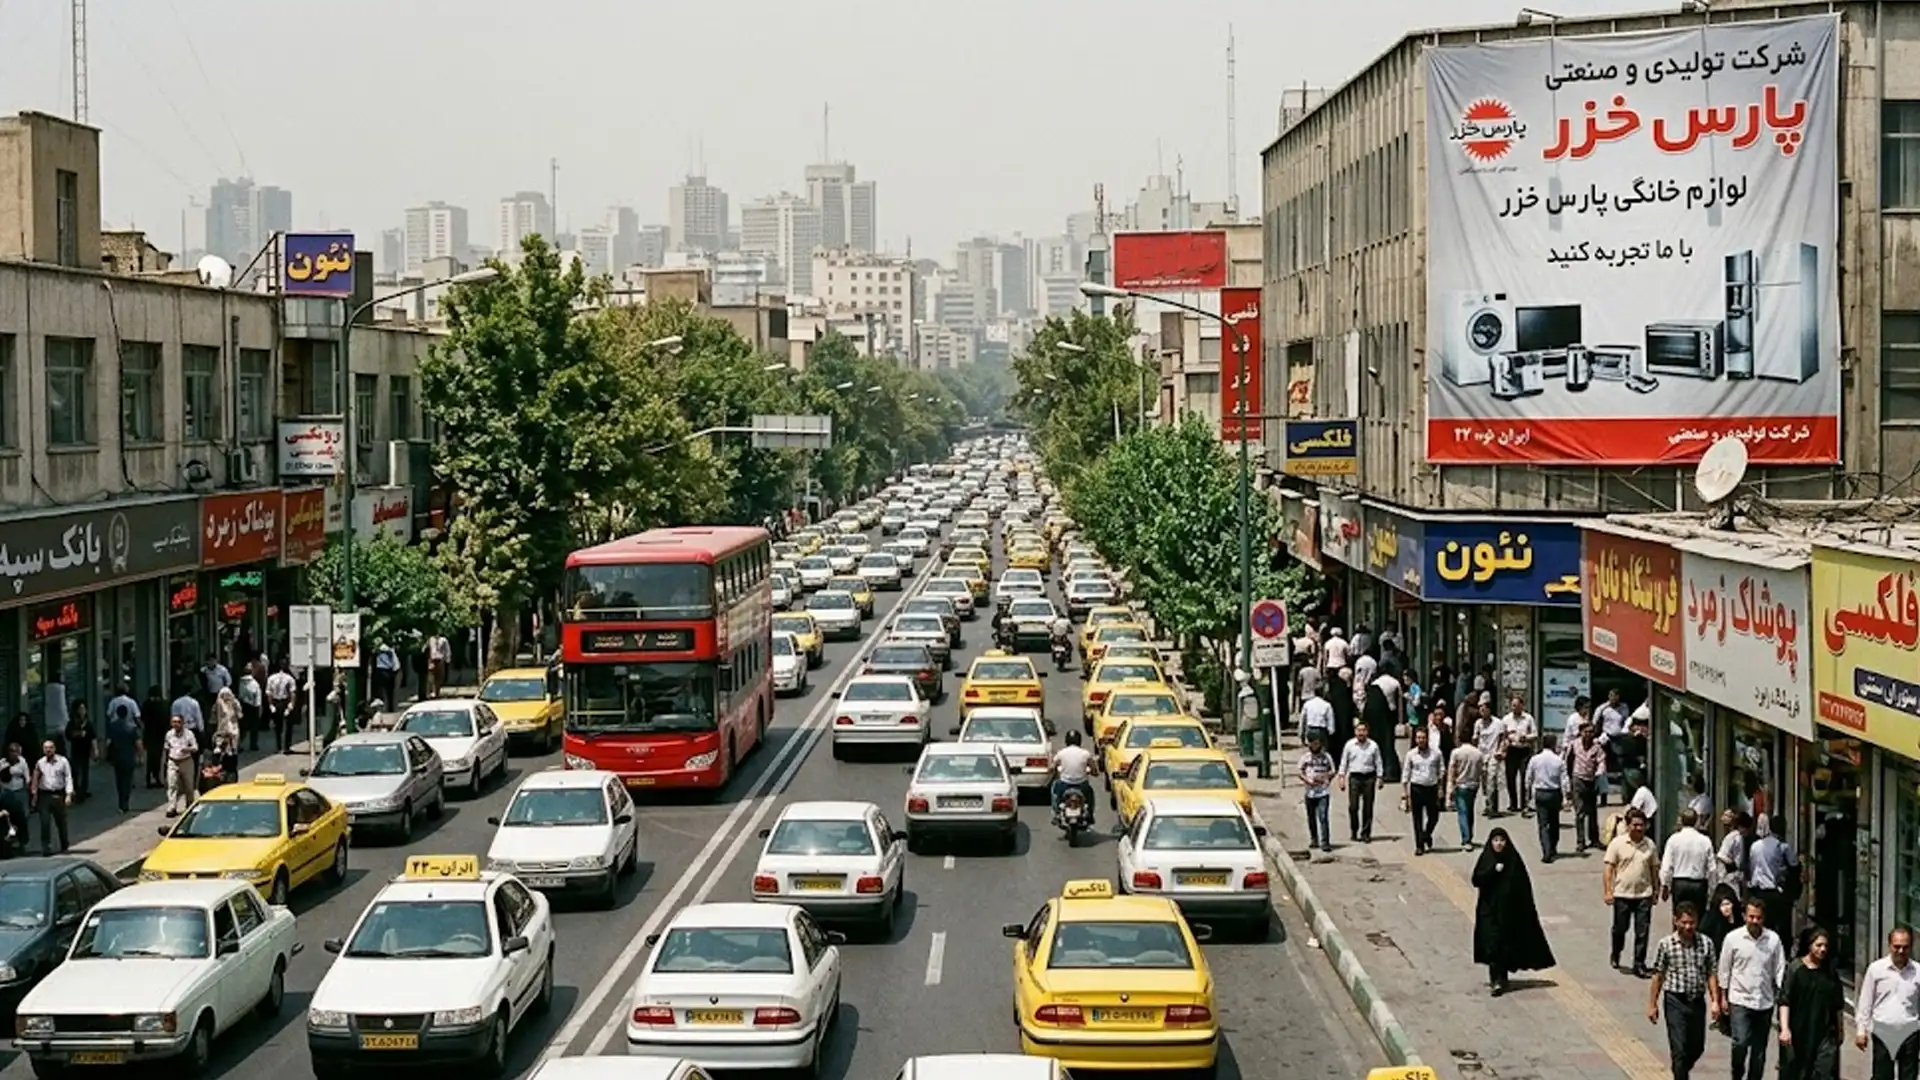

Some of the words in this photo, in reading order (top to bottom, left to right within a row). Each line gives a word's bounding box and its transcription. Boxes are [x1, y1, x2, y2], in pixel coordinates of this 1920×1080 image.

[1626, 61, 1638, 85] و
[1645, 51, 1725, 81] تولیدی
[1732, 42, 1806, 75] شرکت
[1545, 61, 1618, 91] صنعتی
[1543, 95, 1641, 160] خزر
[1652, 85, 1807, 155] پارس
[1499, 185, 1539, 217] خزر
[1546, 183, 1608, 217] پارس
[1614, 176, 1680, 212] خانگی
[1686, 175, 1748, 210] لوازم
[1547, 241, 1590, 269] کنید
[1594, 243, 1650, 267] تجربه
[1655, 239, 1674, 259] ما
[1680, 238, 1693, 264] با
[50, 522, 101, 575] بانک
[1437, 530, 1533, 582] نئون
[1687, 573, 1727, 646] زمرد
[1824, 570, 1919, 656] فلکسی
[1731, 575, 1799, 682] پوشاک
